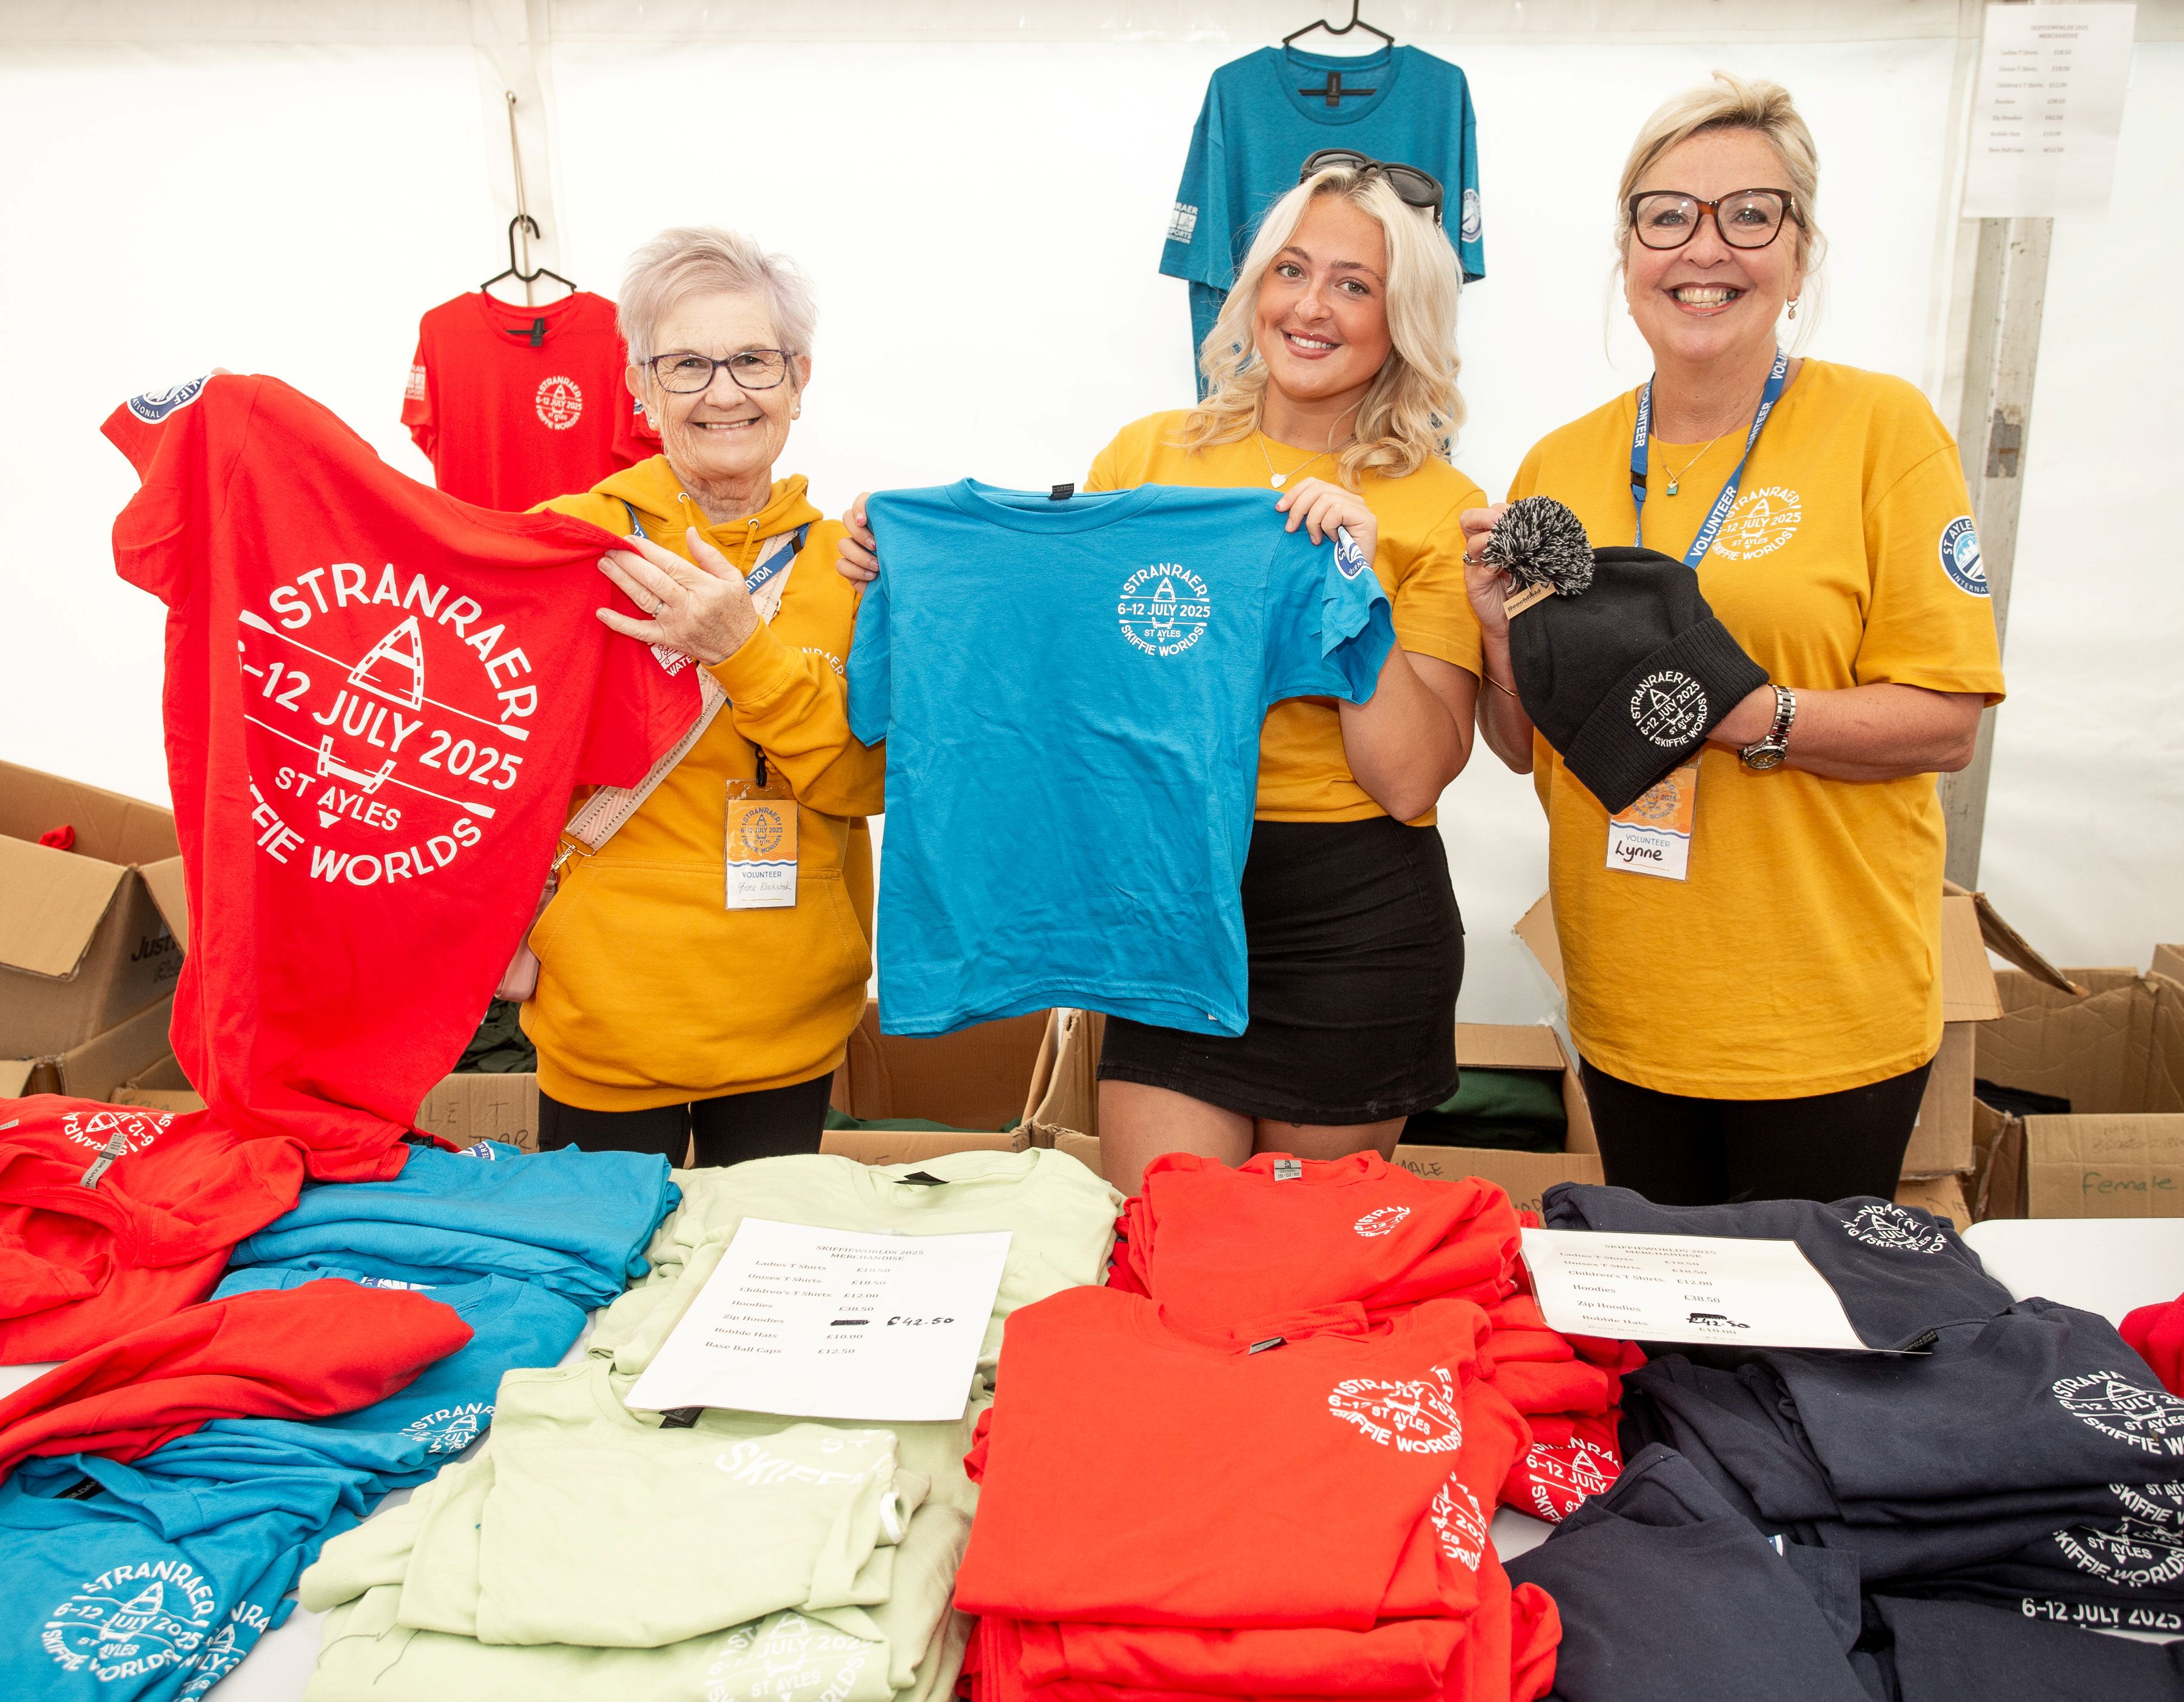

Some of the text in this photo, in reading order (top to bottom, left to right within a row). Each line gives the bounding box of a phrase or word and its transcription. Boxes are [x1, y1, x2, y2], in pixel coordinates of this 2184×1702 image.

[539, 376, 581, 398] STRANRAER
[1726, 487, 1799, 518] STRANRAER
[1690, 485, 1737, 558] VOLUNTEER
[1739, 518, 1770, 529] JULY
[1770, 512, 1802, 525] 2025
[1712, 532, 1792, 561] SKIFFIE WORLDS
[1943, 520, 1974, 555] ST AYLE
[1124, 562, 1207, 597] STRANRAER
[1117, 603, 1211, 618] 6-12 JULY 2025
[269, 562, 538, 722] STRANRAER
[1121, 624, 1204, 657] SKIFFIE WORLDS
[1631, 671, 1684, 719] STRANRAER
[238, 639, 523, 791] -12 JULY 2025
[1640, 681, 1700, 735] 6-12 JULY 2025
[1655, 698, 1707, 747] SKIFFIE WORLDS
[1669, 712, 1694, 735] ST AYLES
[275, 766, 402, 831] ST AYLES
[743, 807, 781, 823] STRANRAER
[309, 818, 482, 886] WORLDS
[1616, 840, 1663, 862] Lynne
[1625, 834, 1670, 848] VOLUNTEER
[419, 1102, 459, 1124] LE
[128, 1120, 154, 1147] 6-12
[2081, 1171, 2177, 1195] Female
[1878, 1228, 1909, 1239] JULY
[816, 1245, 897, 1255] SKIFFIEWORLDS
[1604, 1244, 1688, 1253] SKIFFIEWORLDS
[1569, 1270, 1620, 1278] Children's
[740, 1287, 789, 1295] Children's
[1572, 1284, 1721, 1303] Hoodies £38.50
[1577, 1300, 1594, 1308] Zip
[1597, 1302, 1642, 1312] Hoodies
[715, 1327, 751, 1336] Bobble
[886, 1316, 954, 1326] £42.50
[2059, 1395, 2157, 1410] 6-12 JULY
[1372, 1406, 1431, 1435] ST AYLES
[2124, 1421, 2143, 1430] ST
[1396, 1430, 1461, 1454] WORLDS
[2083, 1417, 2162, 1455] SKIFFIE
[1526, 1454, 1606, 1493] 6-12 JULY
[2146, 1484, 2162, 1495] ST
[2052, 1530, 2111, 1578] KIFFIE
[2088, 1536, 2152, 1559] ST AYLES
[82, 1559, 215, 1619] STRANRAER
[2021, 1598, 2068, 1621] 6-12
[2072, 1604, 2120, 1623] JULY
[53, 1602, 204, 1650] 6-12 JULY 2025
[41, 1629, 89, 1672] SKIFFIE
[98, 1643, 140, 1656] AYLES
[757, 1636, 814, 1658] JULY
[750, 1680, 771, 1698] ST
[775, 1670, 821, 1693] AYLES
